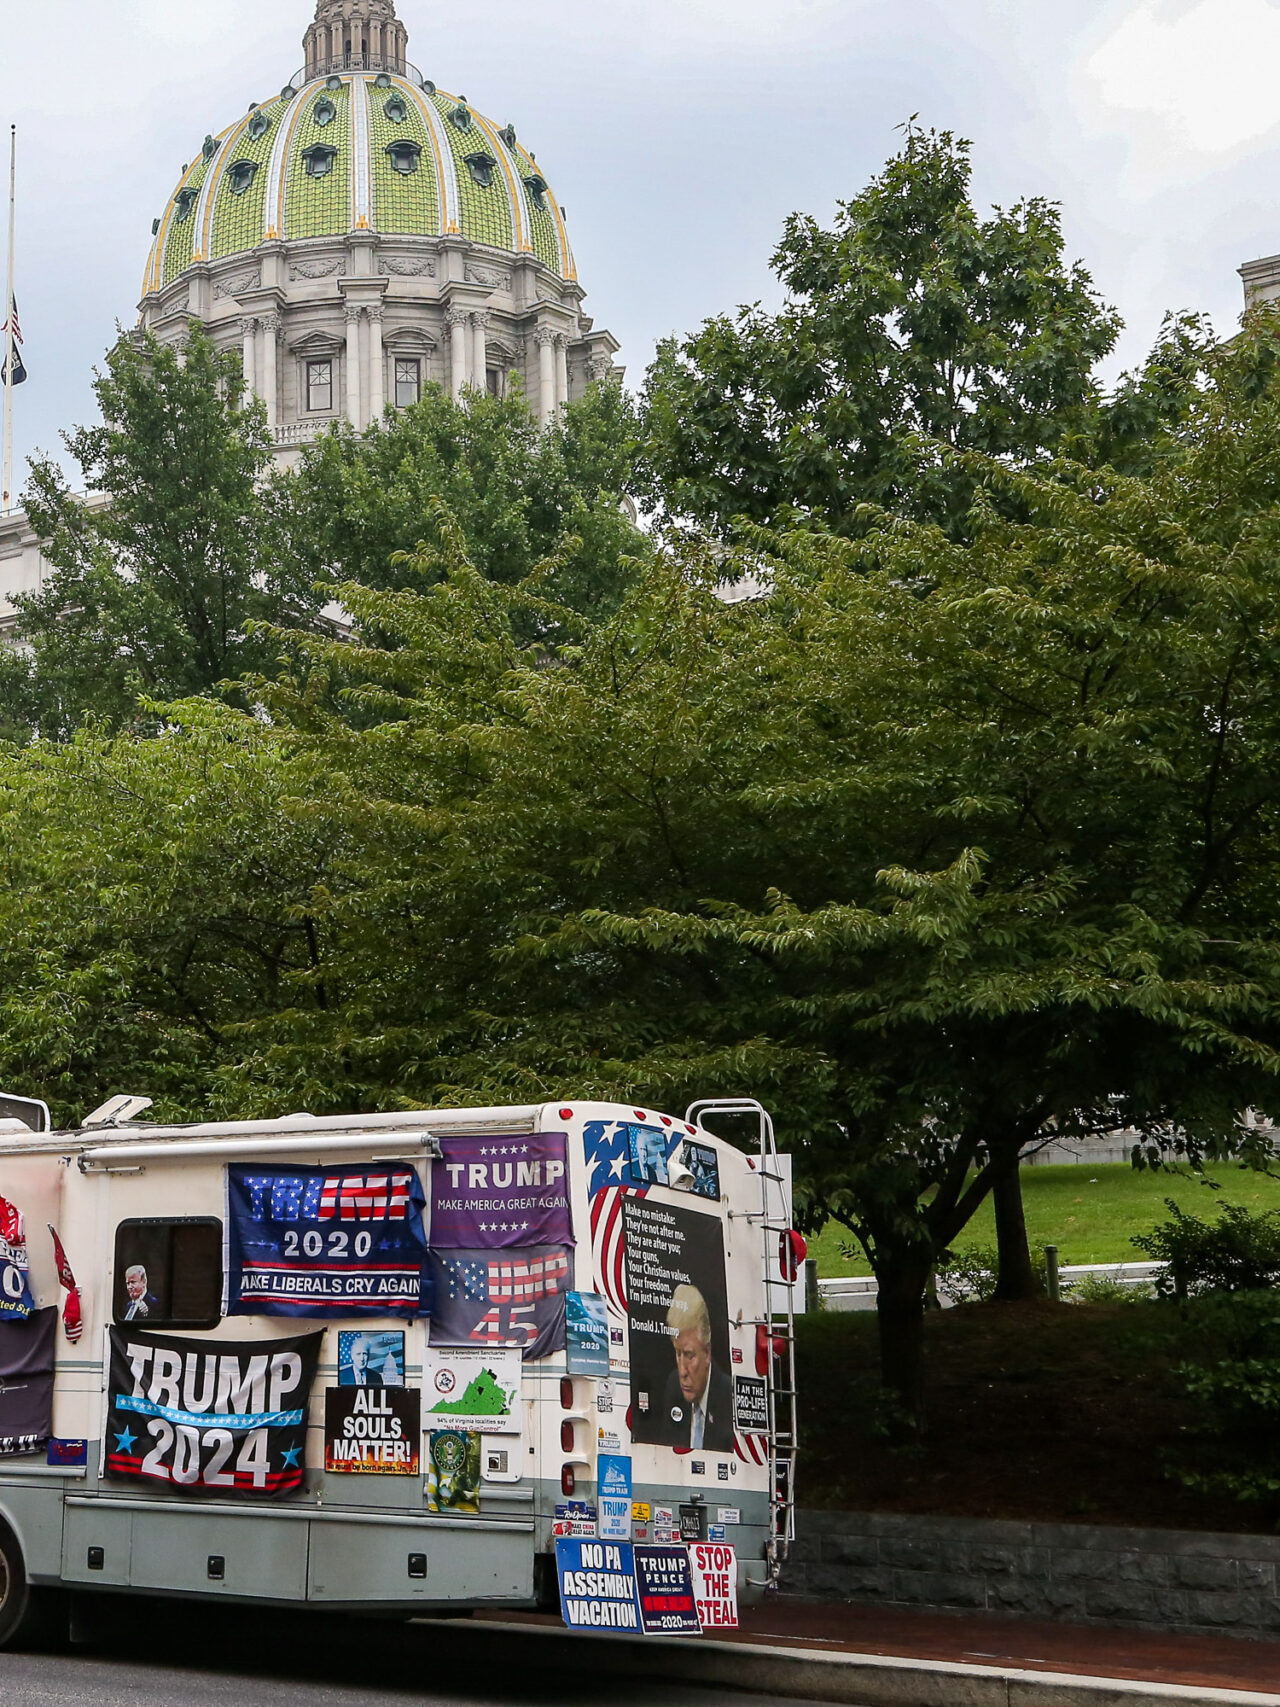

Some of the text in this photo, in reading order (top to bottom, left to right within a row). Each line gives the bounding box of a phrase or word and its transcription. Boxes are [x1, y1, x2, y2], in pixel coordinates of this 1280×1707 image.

[446, 1160, 565, 1189] TRUMP
[438, 1196, 568, 1211] MAKE AMERICA GREAT AGAIN
[625, 1202, 676, 1225] Make no mistake:
[625, 1217, 686, 1241] They're not after me.
[284, 1230, 372, 1257] 2020
[626, 1231, 642, 1247] They
[642, 1238, 652, 1248] are
[653, 1238, 667, 1251] after
[627, 1245, 659, 1264] Your guns,
[628, 1259, 691, 1285] Your Christian values,
[240, 1275, 421, 1294] MAKE LIBERALS CRY AGAIN
[629, 1274, 672, 1293] Your freedom.
[629, 1288, 640, 1301] I'm
[640, 1292, 653, 1305] just
[653, 1295, 660, 1305] in
[660, 1295, 674, 1308] their
[468, 1303, 539, 1347] 45
[573, 1322, 605, 1334] TRUMP
[631, 1318, 654, 1333] Donald
[660, 1323, 680, 1339] Trump
[581, 1341, 600, 1350] 2020
[127, 1343, 302, 1414] TRUMP
[741, 1384, 750, 1394] AM
[752, 1386, 764, 1396] THE
[353, 1389, 393, 1415] ALL
[736, 1395, 766, 1410] PRO-LIFE
[738, 1409, 766, 1421] GENERATION
[343, 1416, 402, 1440] SOULS
[19, 1434, 38, 1450] IT
[141, 1418, 271, 1487] 2024
[333, 1439, 411, 1463] MATTER!
[353, 1463, 361, 1471] be
[361, 1463, 377, 1471] born
[602, 1501, 628, 1517] TRUMP
[580, 1543, 622, 1570] NO PA
[640, 1557, 686, 1572] TRUMP
[696, 1546, 732, 1571] STOP
[563, 1571, 634, 1600] ASSEMBLY
[646, 1573, 685, 1584] PENCE
[703, 1573, 729, 1598] THE
[566, 1600, 638, 1628] VACATION
[661, 1615, 683, 1629] 2020
[696, 1600, 738, 1625] STEAL
